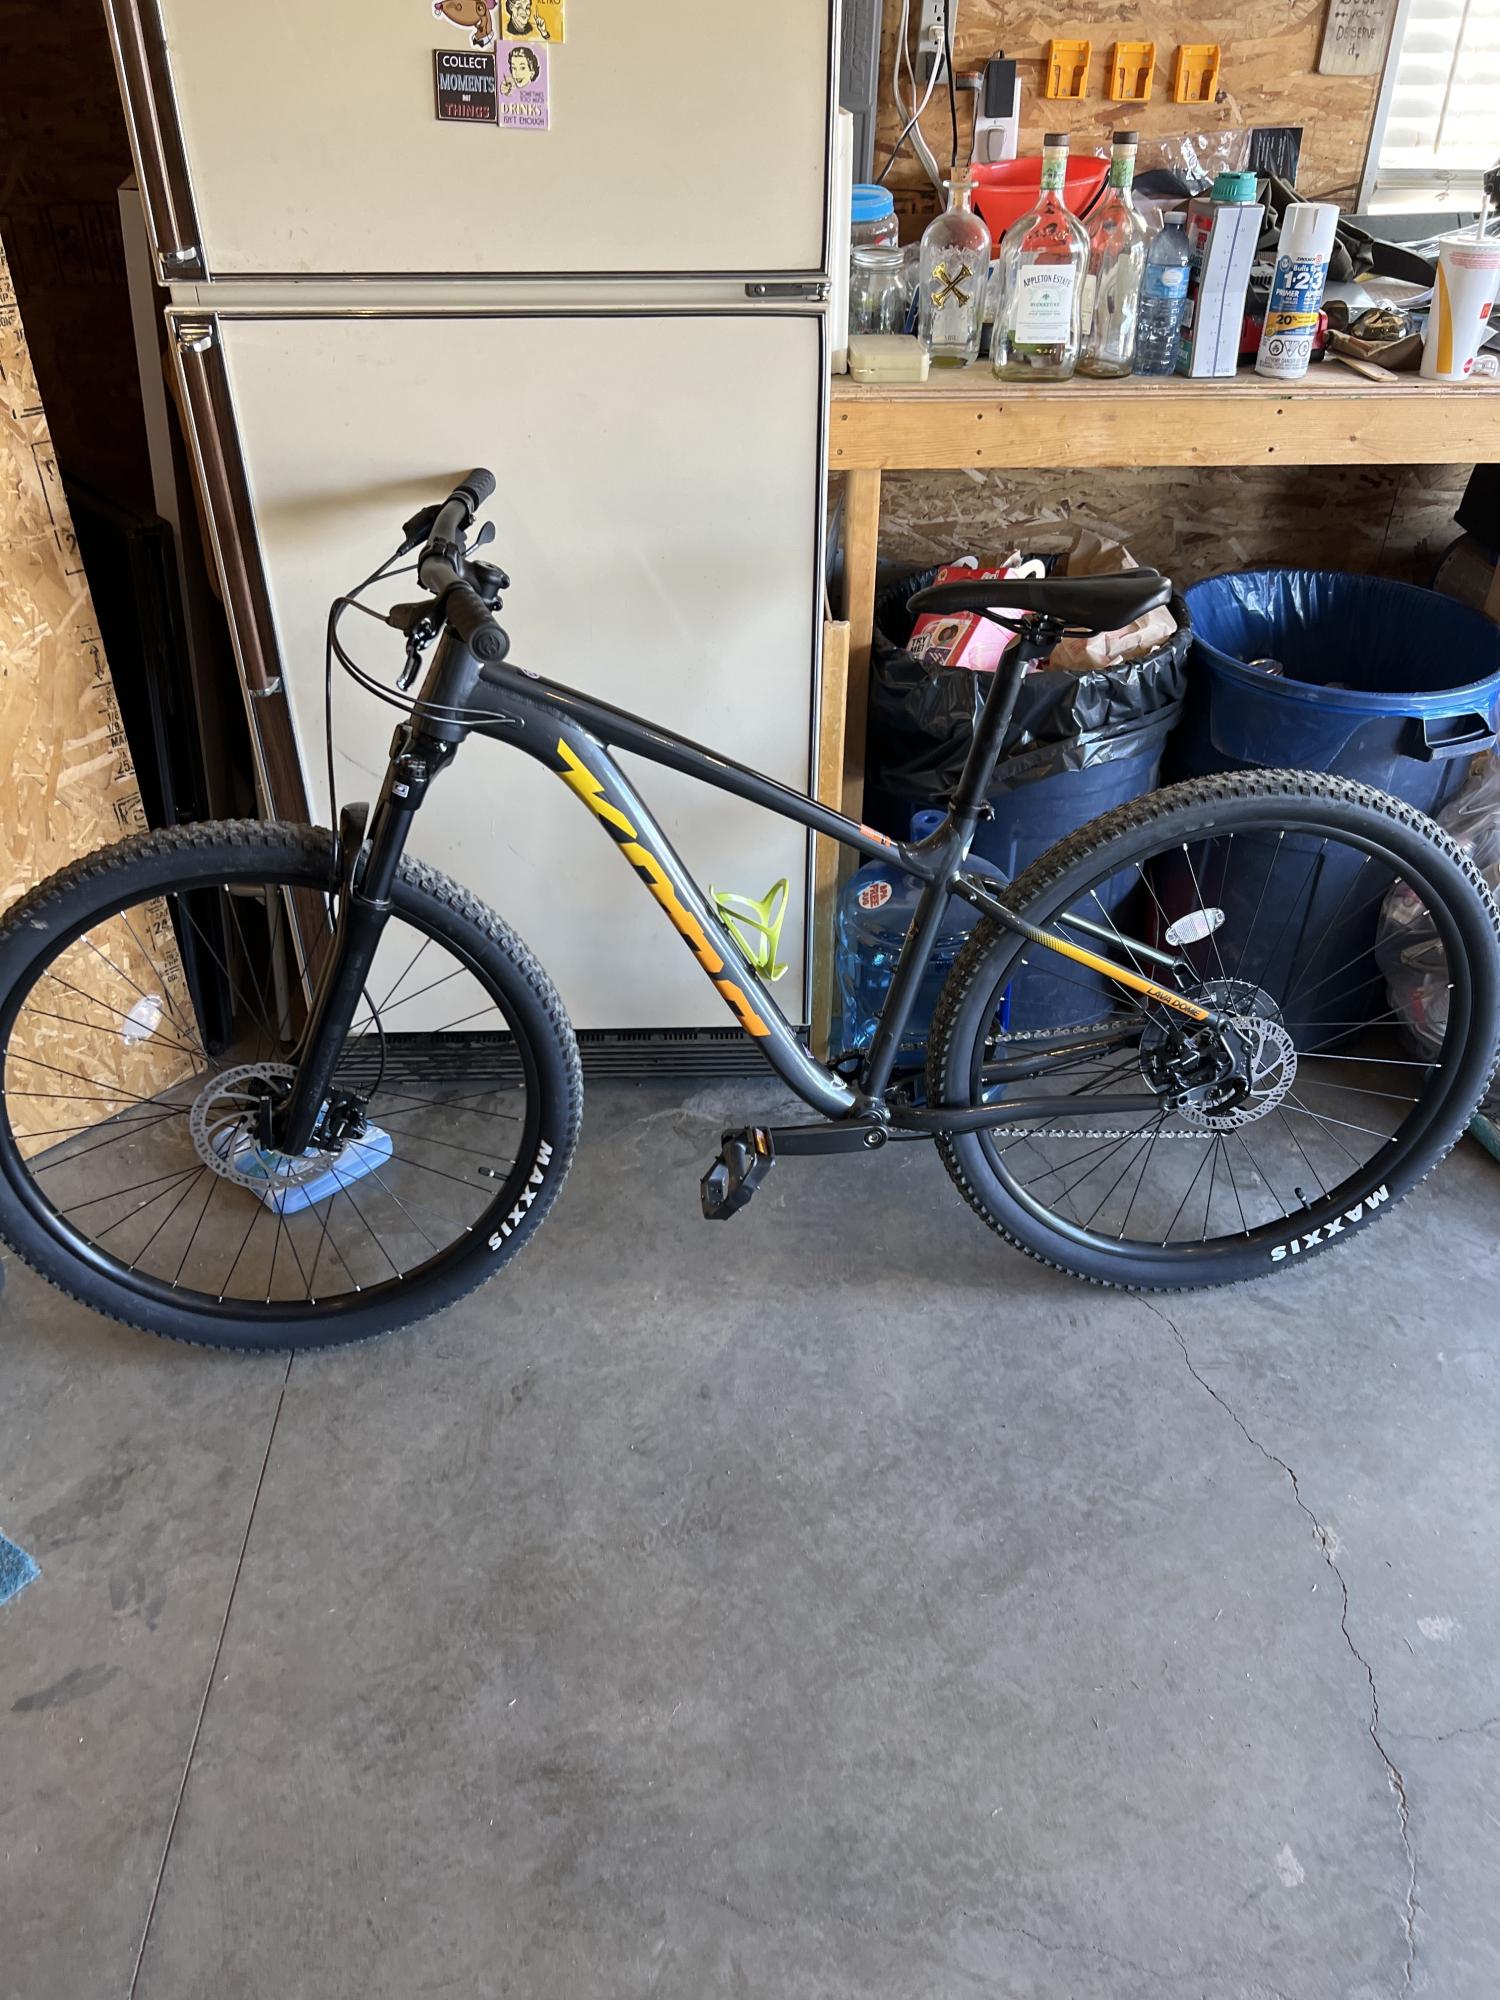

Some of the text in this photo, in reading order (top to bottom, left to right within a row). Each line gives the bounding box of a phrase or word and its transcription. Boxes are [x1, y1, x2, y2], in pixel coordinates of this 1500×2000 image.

[1336, 25, 1376, 40] DESERVE
[443, 56, 488, 69] COLLECT
[440, 73, 495, 93] MOMENTS
[445, 103, 490, 119] THINGS
[502, 103, 542, 117] DRINKS
[1023, 274, 1052, 287] APPLETON
[1147, 986, 1201, 1018] LAVA DOME
[488, 1139, 553, 1251] MAXXIS
[1270, 1184, 1389, 1261] MAXXIS
